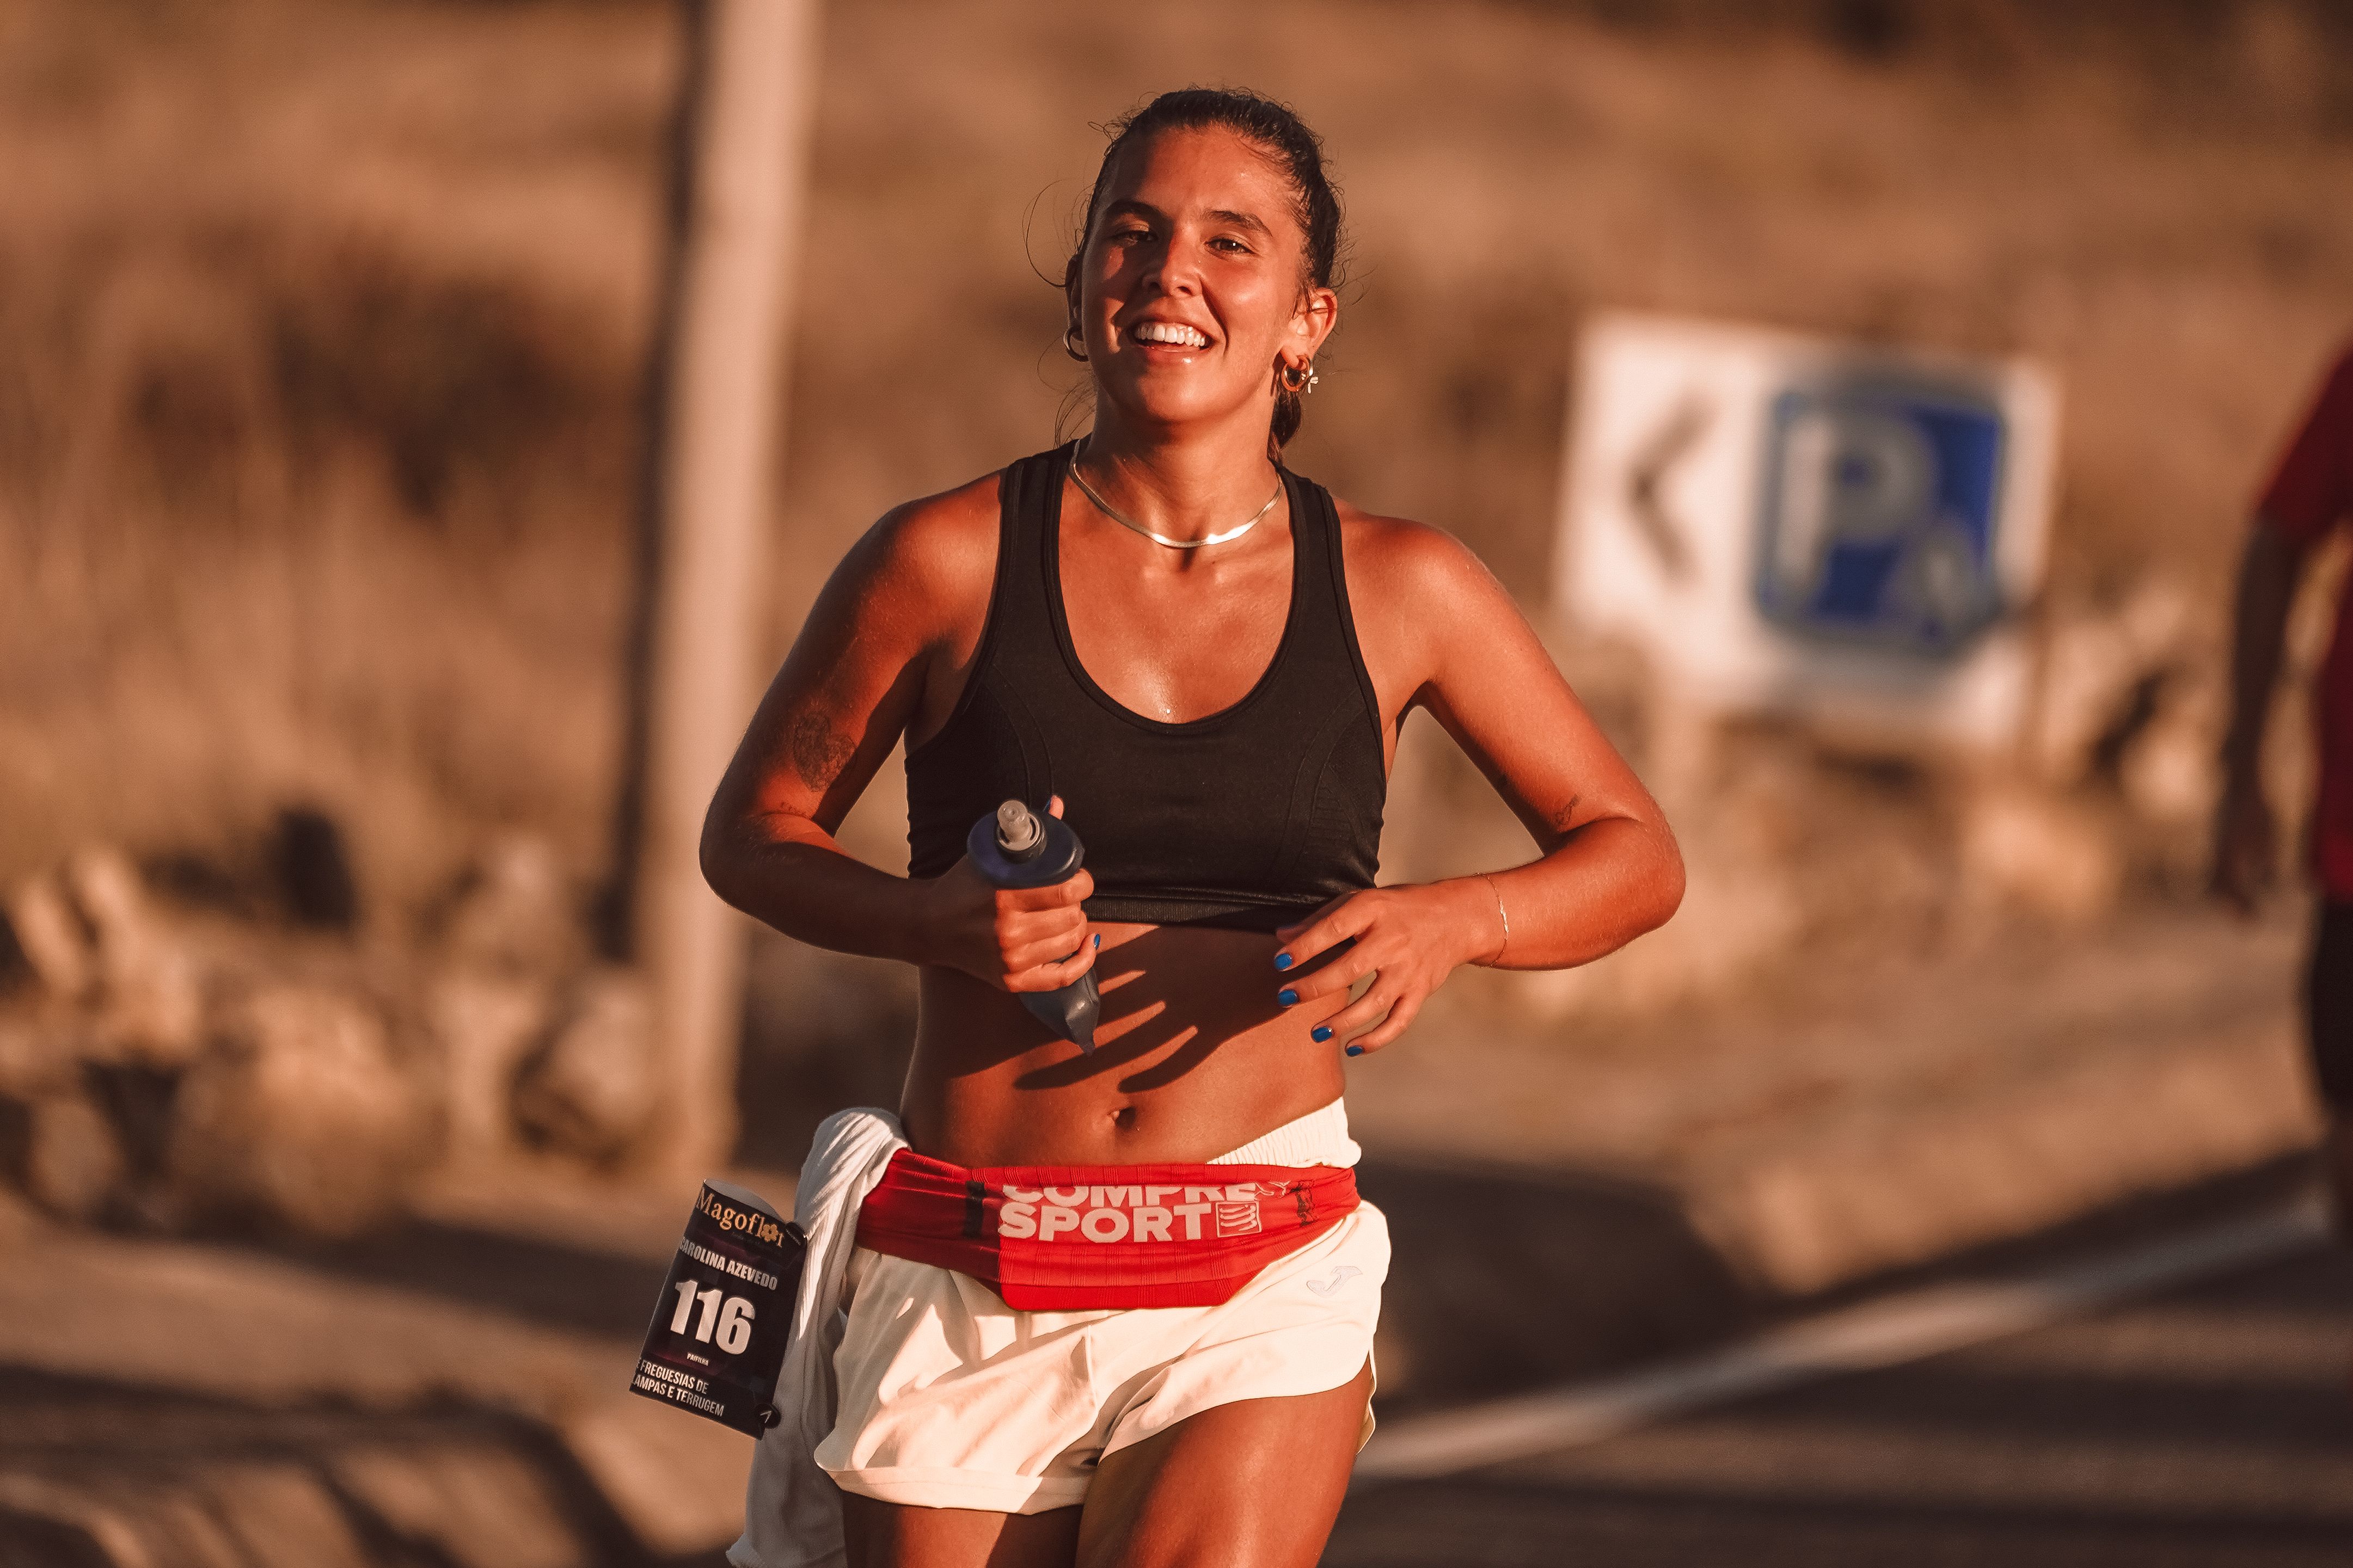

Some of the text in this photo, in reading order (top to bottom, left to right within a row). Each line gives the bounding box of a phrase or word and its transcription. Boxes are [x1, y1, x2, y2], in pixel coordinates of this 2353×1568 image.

[1774, 414, 1930, 588] P
[997, 1202, 1211, 1243] SPORT
[679, 1237, 726, 1271] CAROLINA
[726, 1259, 778, 1291] AZEVEDO
[670, 1280, 756, 1355] 116
[632, 1374, 725, 1417] AMPAS E TERRUGEM
[640, 1360, 695, 1389] FREGUESIAS
[695, 1380, 709, 1395] DE
